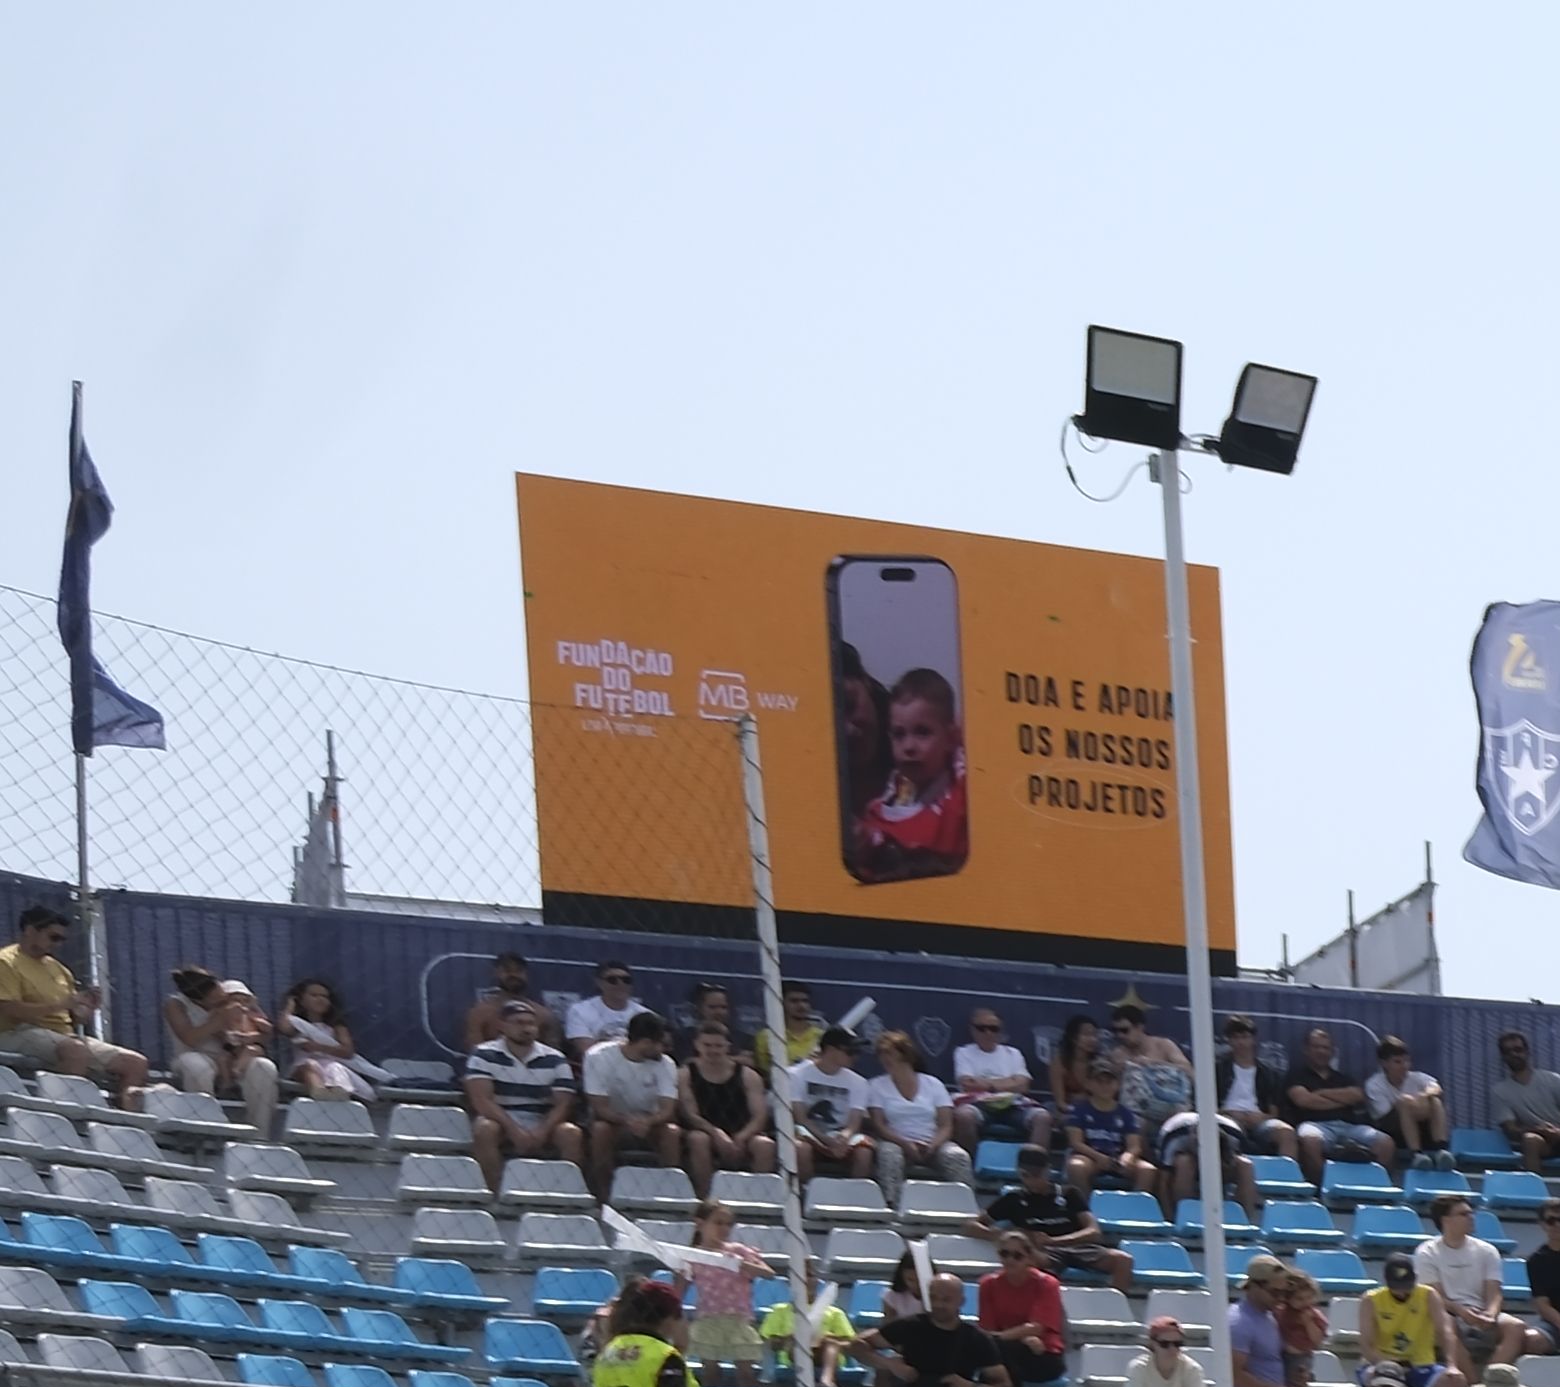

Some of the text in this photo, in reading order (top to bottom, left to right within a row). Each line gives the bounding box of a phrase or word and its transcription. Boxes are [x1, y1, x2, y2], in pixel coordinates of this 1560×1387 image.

[602, 667, 632, 690] DO
[699, 682, 799, 711] MB WAY
[1005, 672, 1060, 709] DOA
[1072, 680, 1086, 711] E
[574, 683, 675, 717] FUTEBOL
[1018, 723, 1170, 770] OS NOSSOS
[1028, 774, 1167, 819] PROJETOS
